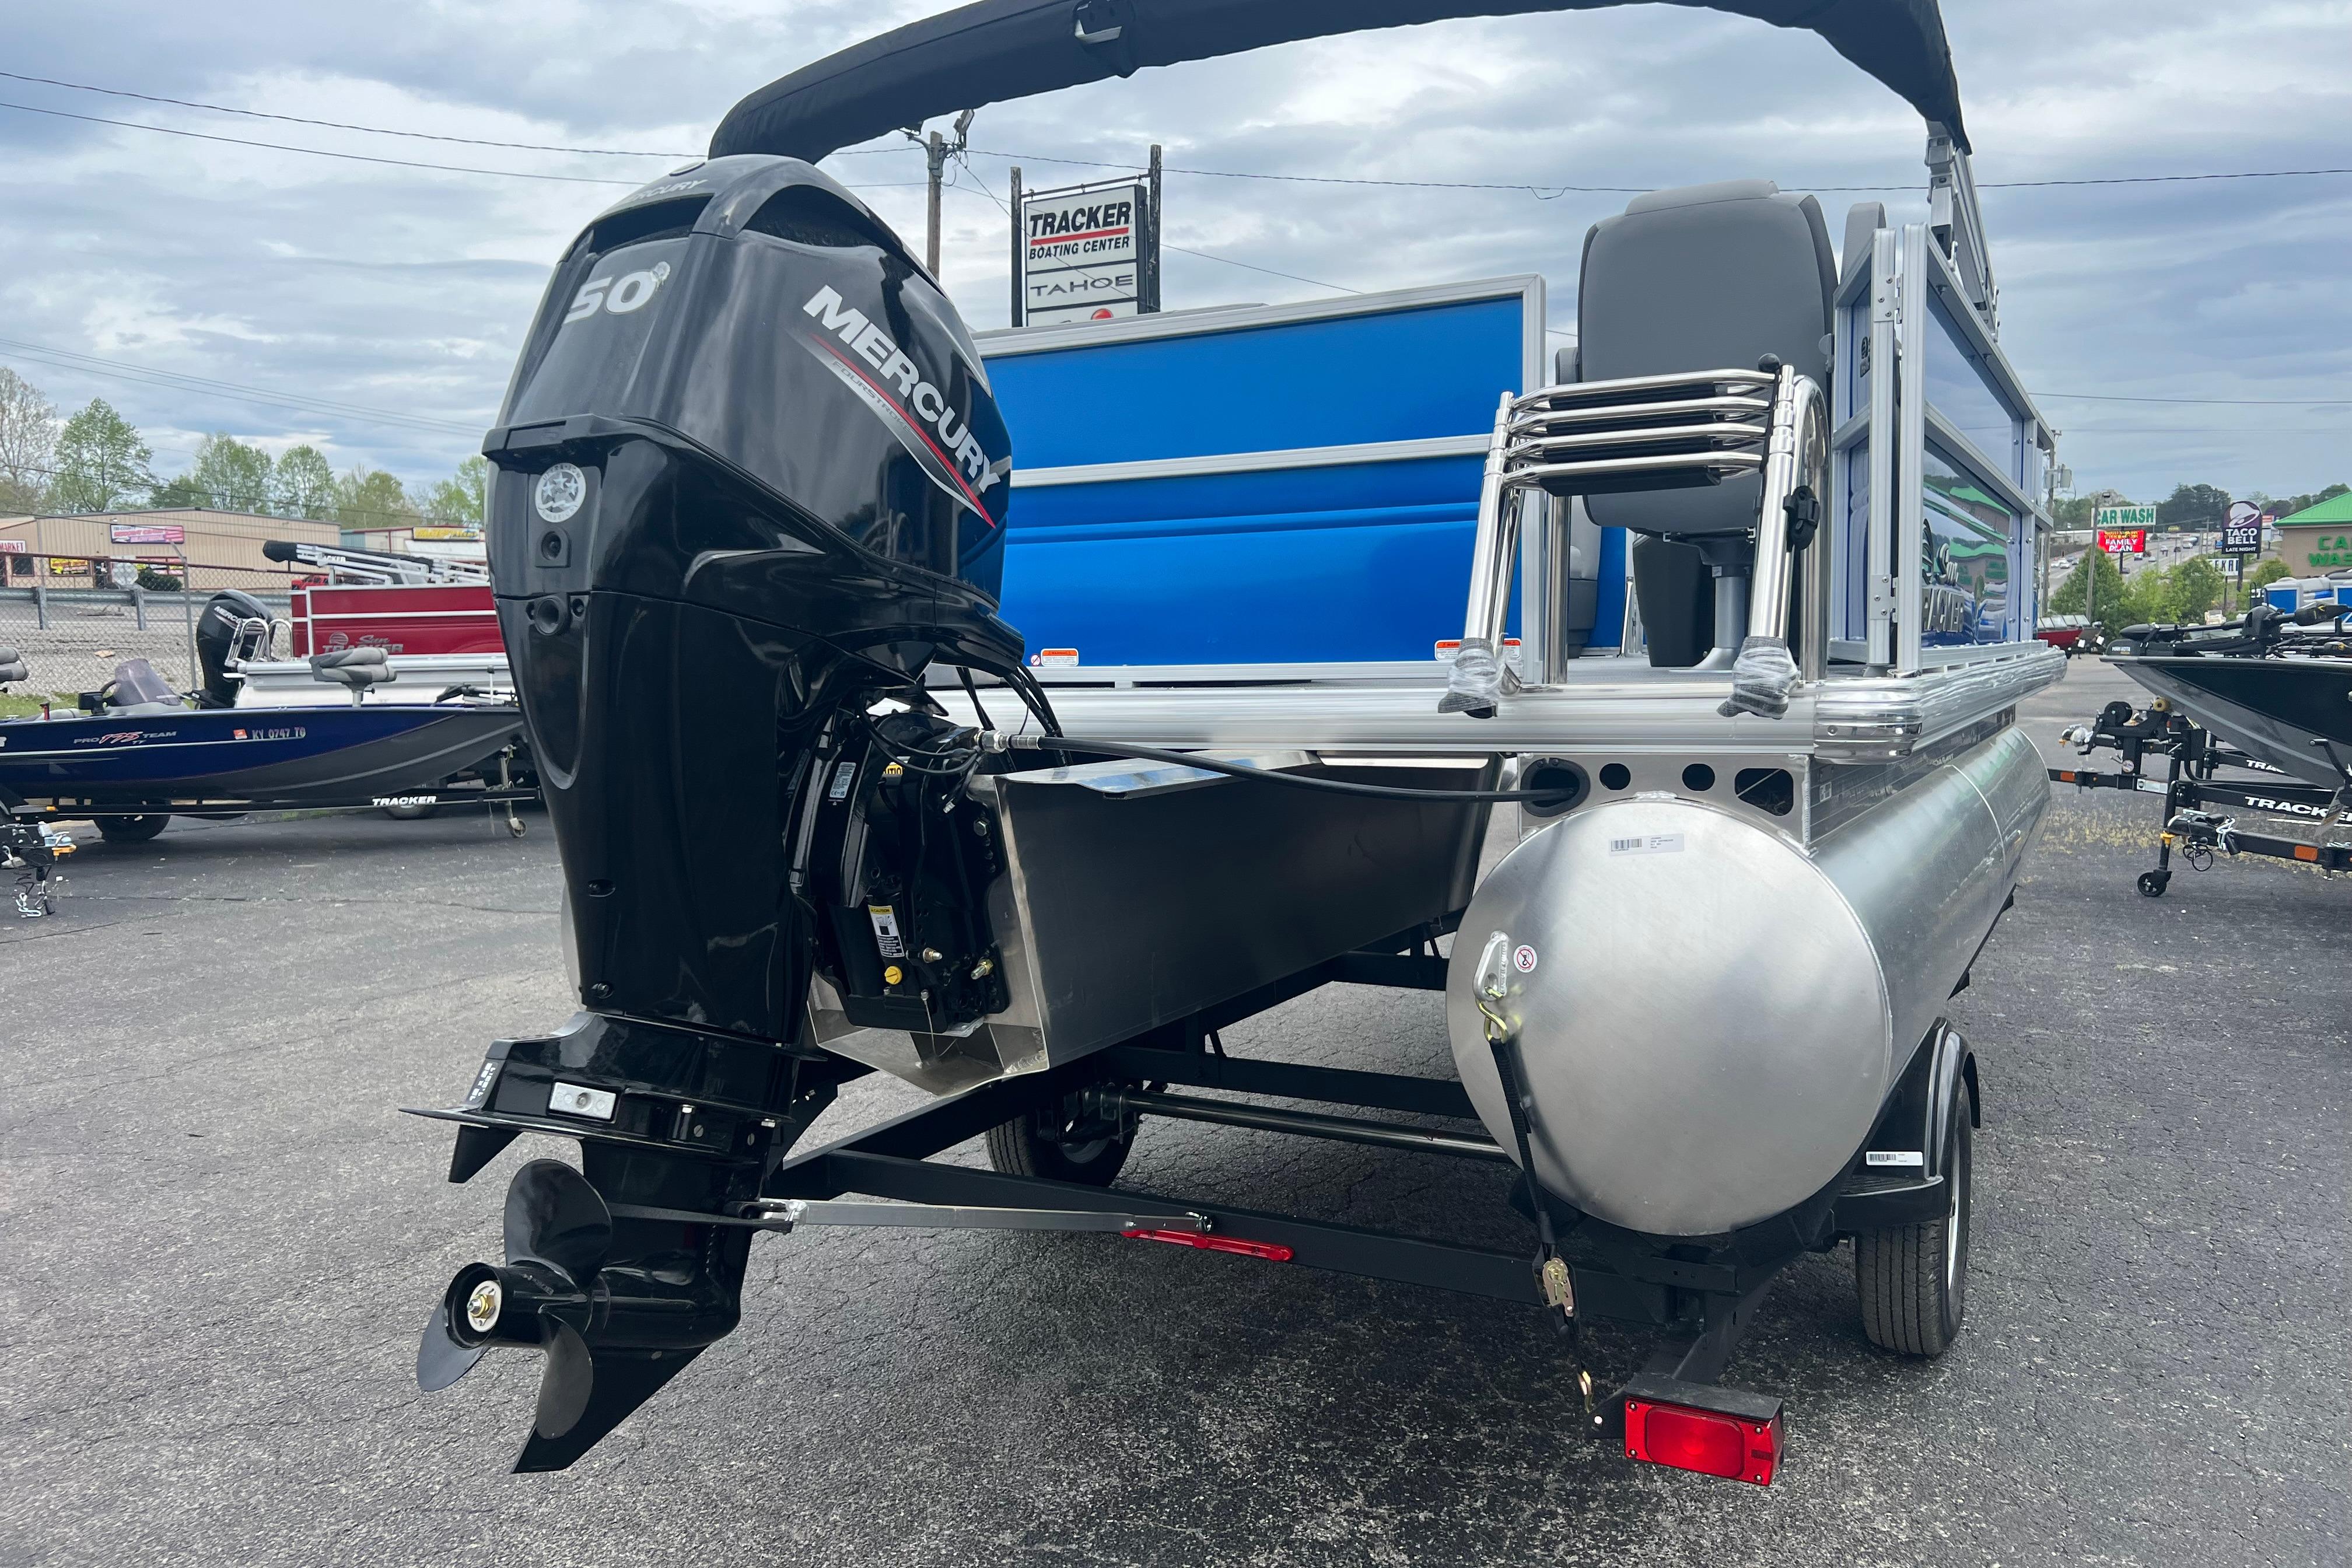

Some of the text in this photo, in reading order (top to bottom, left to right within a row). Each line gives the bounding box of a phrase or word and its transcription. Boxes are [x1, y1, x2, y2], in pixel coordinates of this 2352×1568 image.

[1030, 201, 1132, 237] TRACKER
[1029, 236, 1129, 260] BOATING CENTER
[1030, 274, 1133, 297] TAHOE
[803, 284, 1001, 494] MERCURY
[832, 359, 912, 433] FOURSTROKE
[2120, 508, 2155, 524] WASH
[2225, 527, 2258, 536] TACO
[2227, 536, 2256, 545] BELL
[2318, 535, 2352, 551] CA
[322, 643, 404, 653] TRAER
[251, 729, 264, 740] KY
[2246, 760, 2285, 774] TRA
[371, 795, 437, 806] TRACKER
